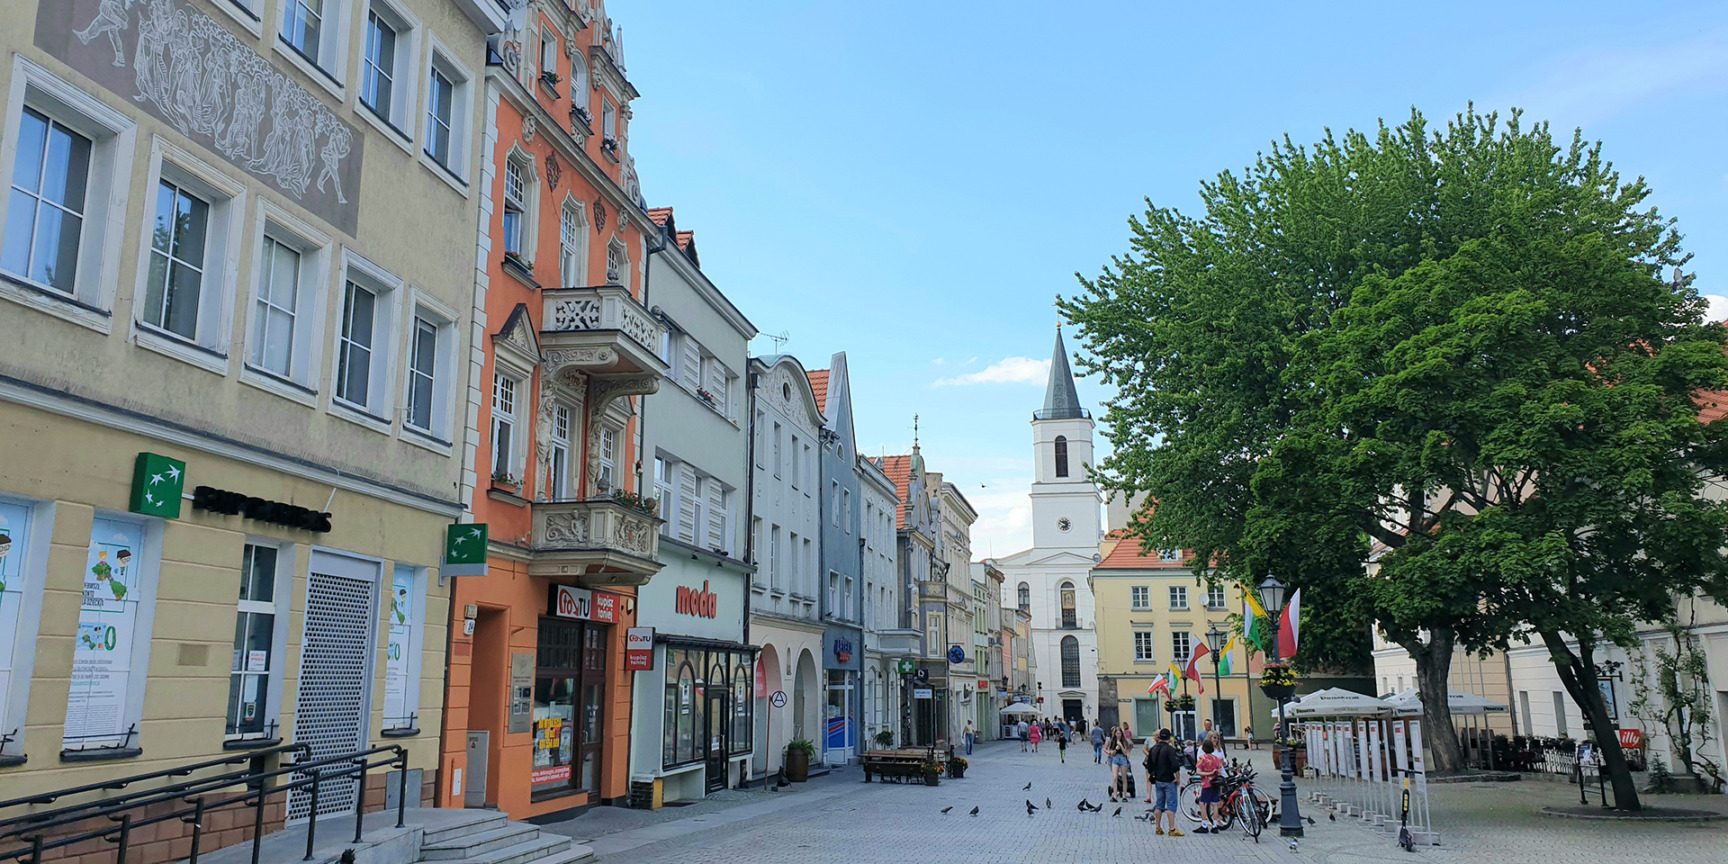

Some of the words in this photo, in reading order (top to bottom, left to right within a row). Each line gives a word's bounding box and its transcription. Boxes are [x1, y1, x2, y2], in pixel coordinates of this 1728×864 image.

[597, 593, 613, 609] kupisz
[676, 580, 717, 619] moda
[597, 606, 613, 622] taniej
[1622, 731, 1640, 746] illy
